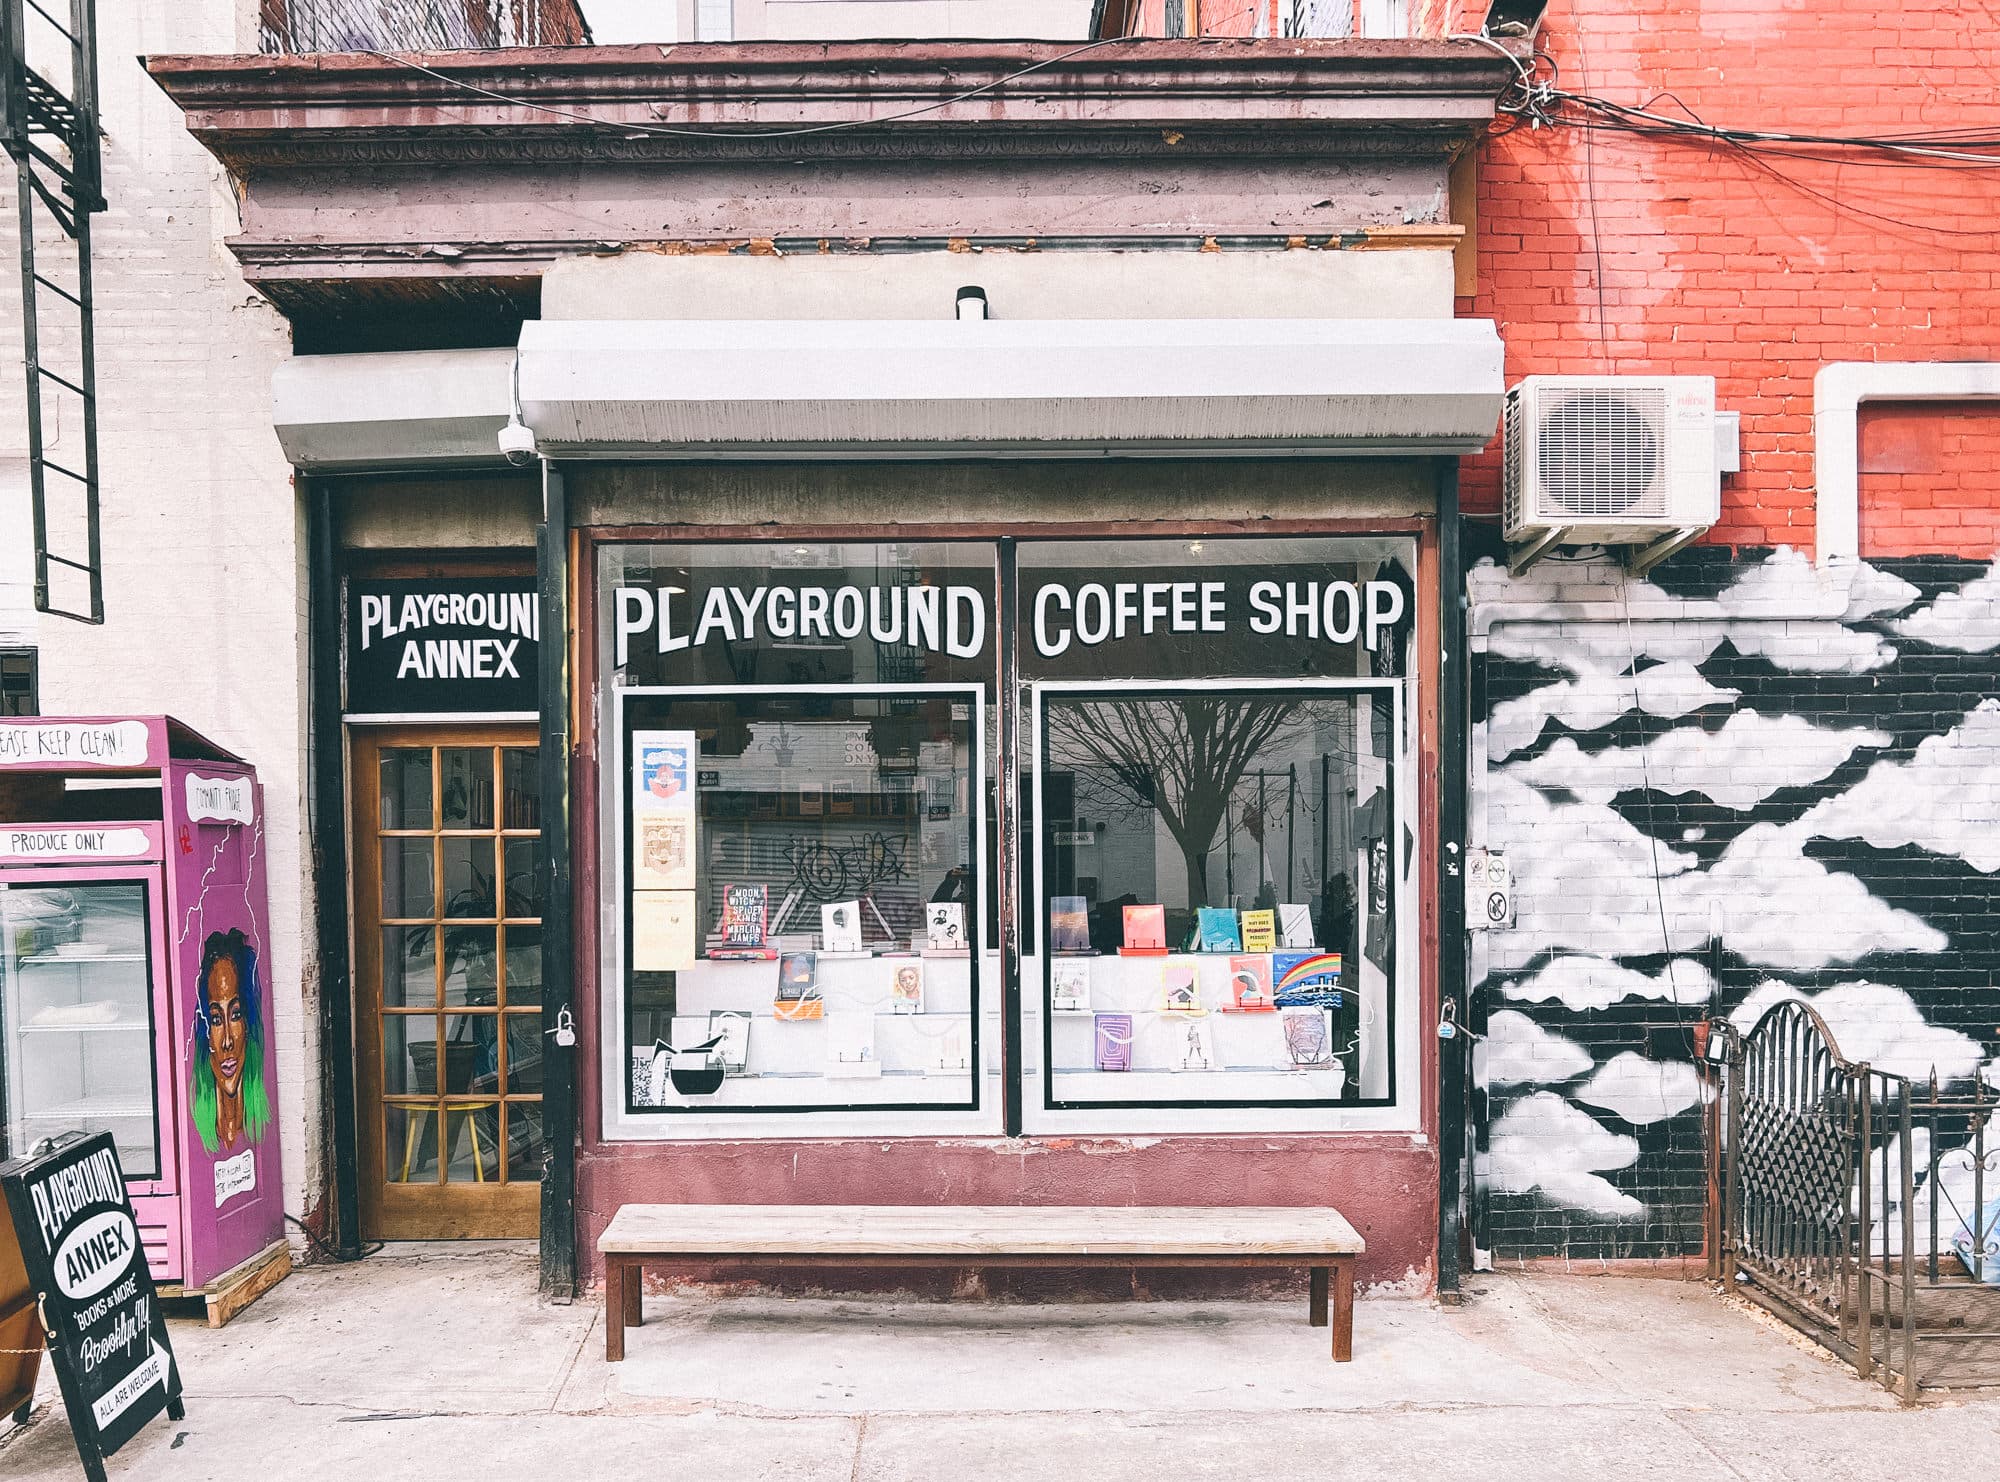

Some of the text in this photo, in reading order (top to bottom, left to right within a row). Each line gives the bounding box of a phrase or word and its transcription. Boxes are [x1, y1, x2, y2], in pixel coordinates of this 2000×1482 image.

[614, 581, 1404, 668] PLAYGROUND COFFEE SHOP
[396, 639, 521, 678] ANNEX
[0, 729, 125, 757] EASE KEEP CLEAN!
[12, 832, 105, 852] PRODUCE ONLY
[733, 905, 763, 914] SPIDER
[736, 888, 759, 898] MOON
[731, 933, 760, 942] JAMES
[31, 1147, 124, 1256] PLAYGROUND
[65, 1220, 130, 1290] ANNEX
[99, 1360, 160, 1419] ALL ARE WELCOME
